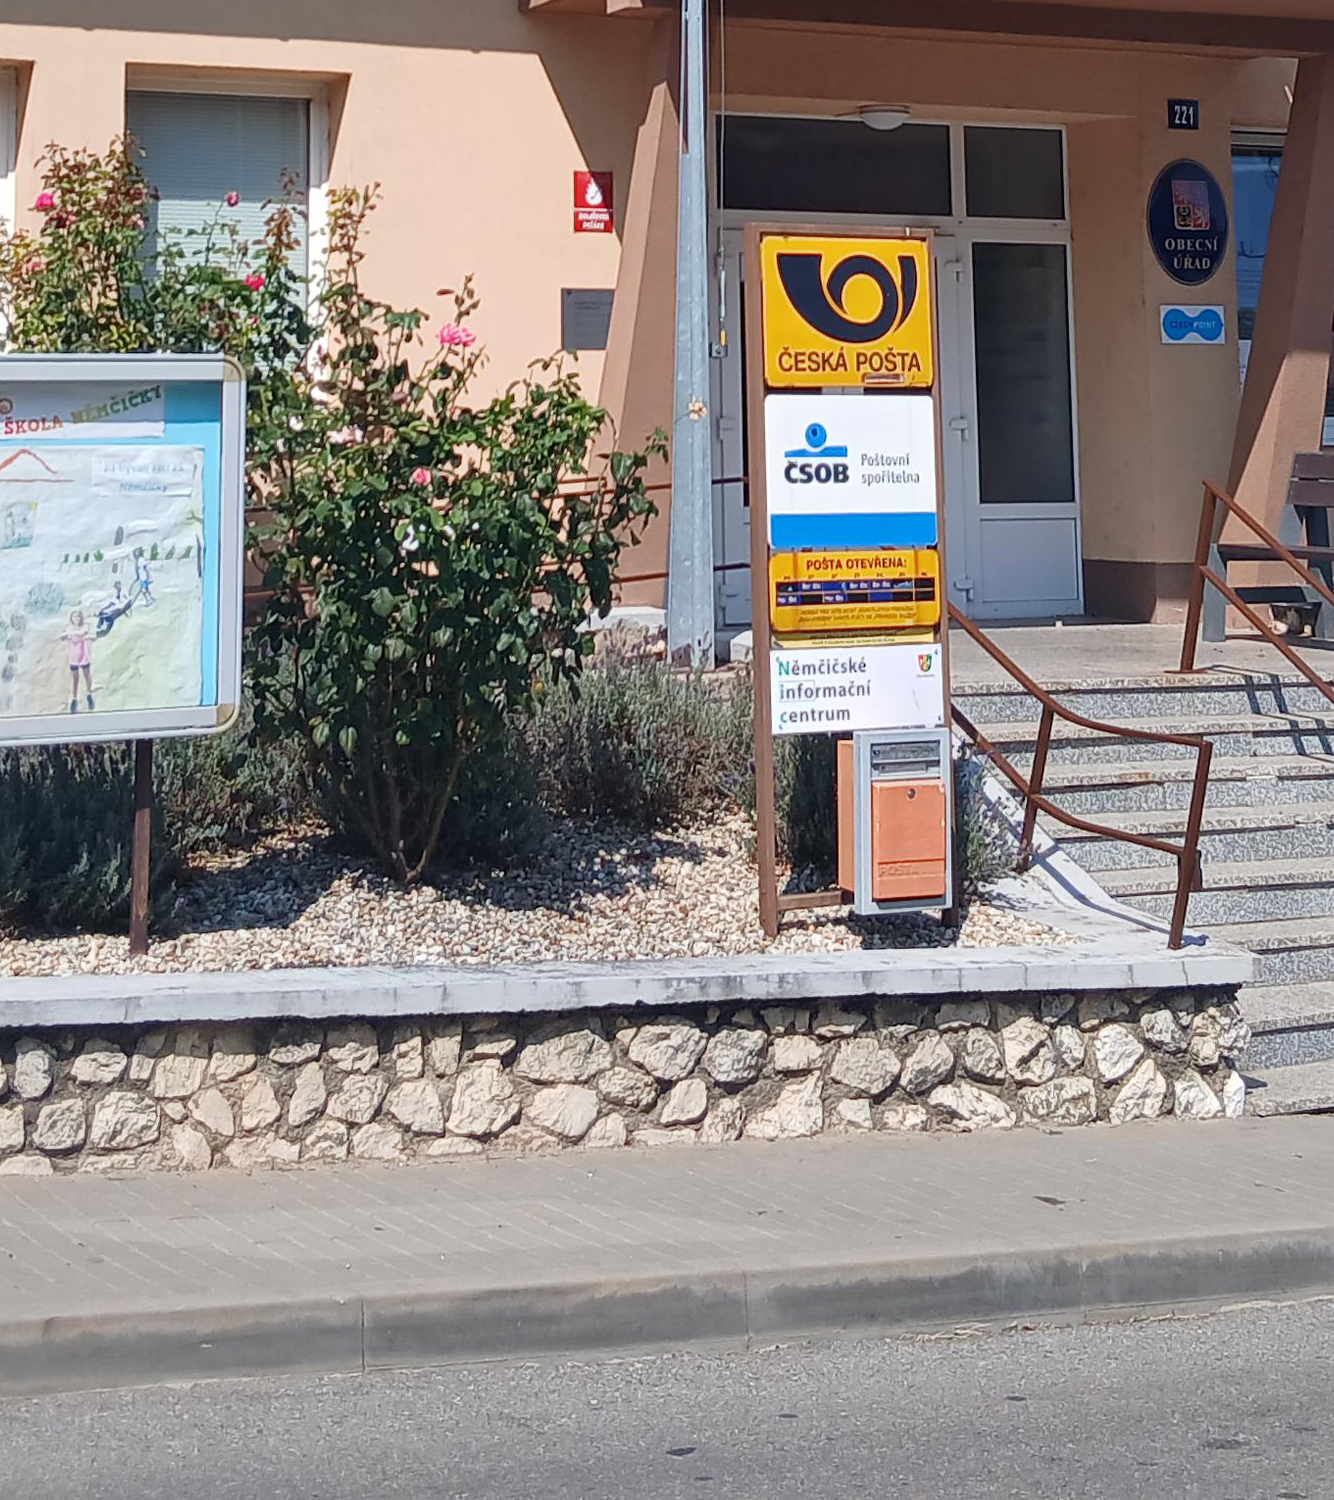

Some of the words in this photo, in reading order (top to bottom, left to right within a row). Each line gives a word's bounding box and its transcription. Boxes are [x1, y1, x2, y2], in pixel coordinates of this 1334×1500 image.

[1174, 104, 1194, 126] 221
[1164, 236, 1218, 251] OBECNÍ
[1173, 252, 1211, 270] ÚŘAD
[778, 346, 848, 372] ČESKÁ
[855, 347, 922, 373] POŠTA
[4, 415, 63, 435] ŠKOLA
[71, 384, 163, 424] NĚMČIČKY
[861, 453, 910, 467] Poštovní
[784, 461, 850, 484] ČSOB
[861, 470, 920, 487] spořitelna
[806, 557, 843, 570] POŠTA
[845, 555, 907, 570] OTEVŘENA:
[778, 656, 867, 676] Němčičské
[780, 679, 871, 699] informační
[780, 708, 851, 724] centrum
